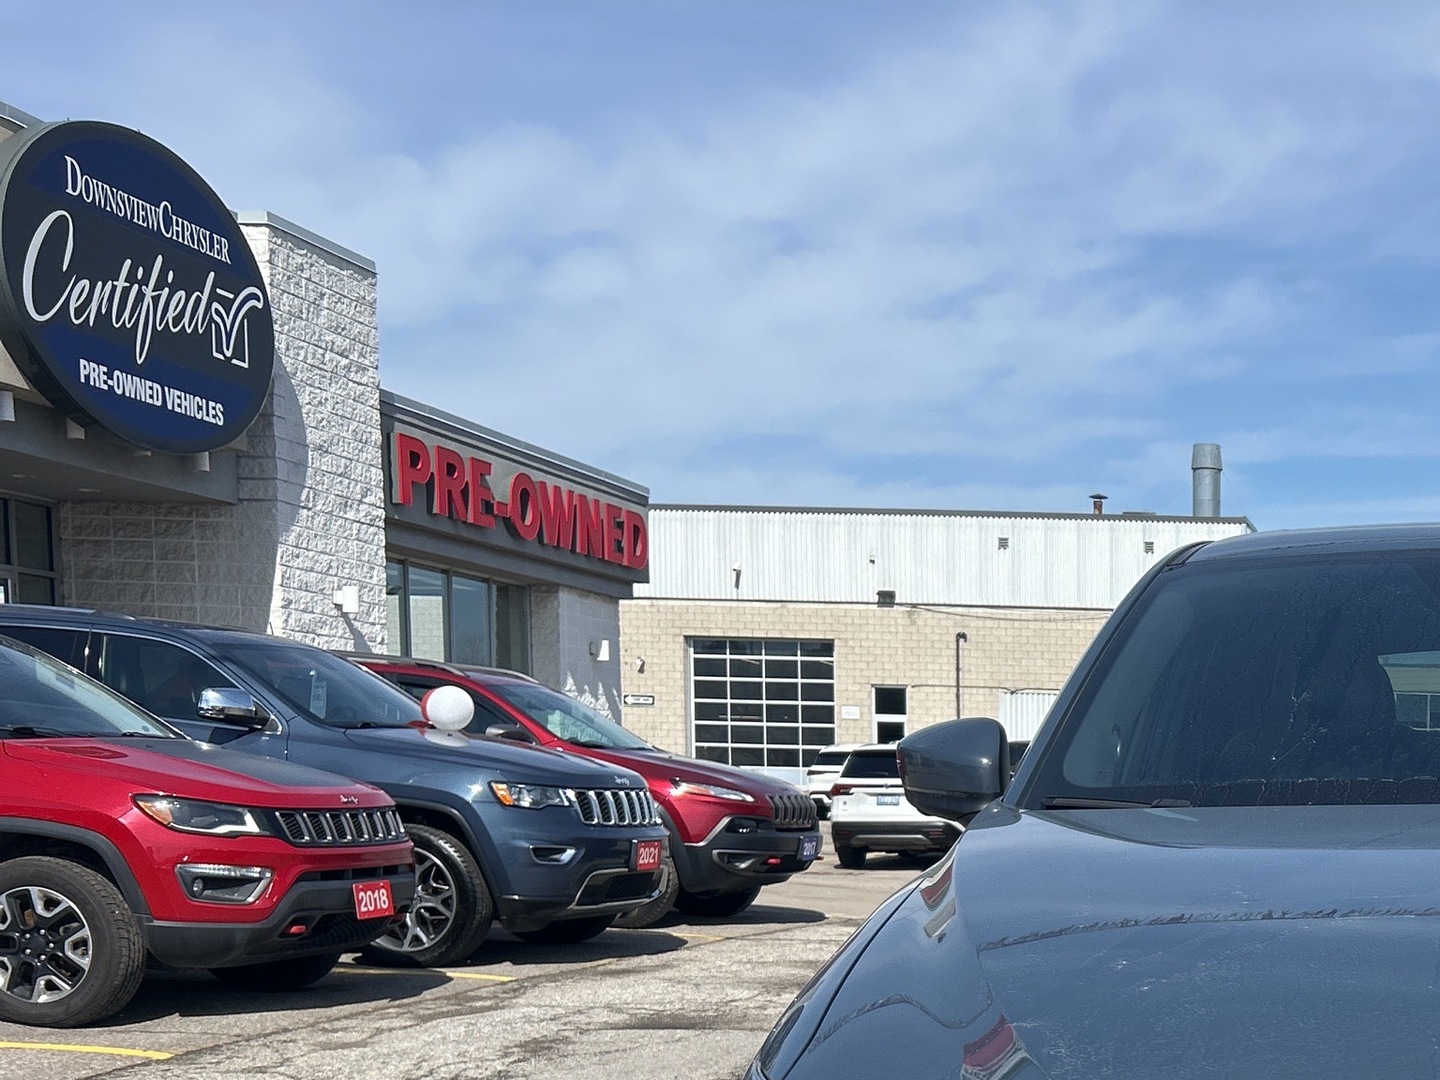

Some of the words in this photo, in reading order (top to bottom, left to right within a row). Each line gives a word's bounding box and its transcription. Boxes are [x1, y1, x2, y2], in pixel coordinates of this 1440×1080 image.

[22, 209, 216, 365] Certified
[79, 358, 162, 407] PRE-OWNED
[164, 386, 224, 426] VEHICLES
[396, 432, 648, 570] PRE-OWNED
[639, 847, 659, 864] 2021
[359, 889, 389, 912] 2018
